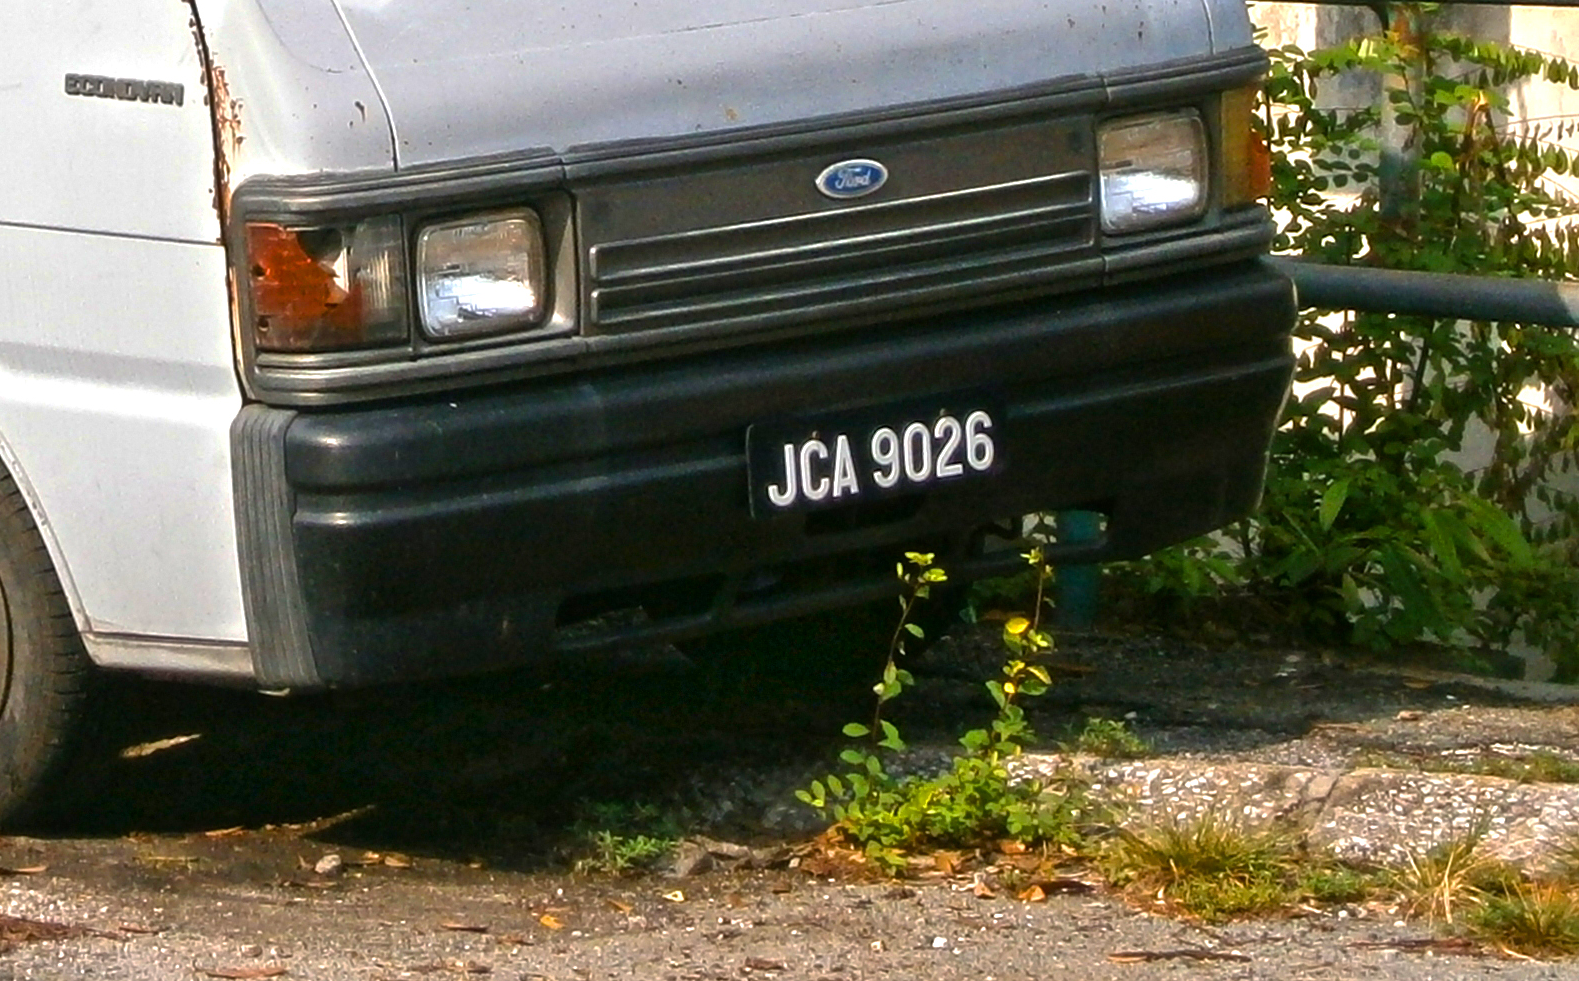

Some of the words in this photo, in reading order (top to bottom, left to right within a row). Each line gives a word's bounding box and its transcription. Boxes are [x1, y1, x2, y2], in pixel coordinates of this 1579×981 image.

[64, 73, 185, 108] ECONOVAN
[835, 167, 872, 189] Ford
[768, 434, 859, 507] JCA
[871, 409, 996, 489] 9026
